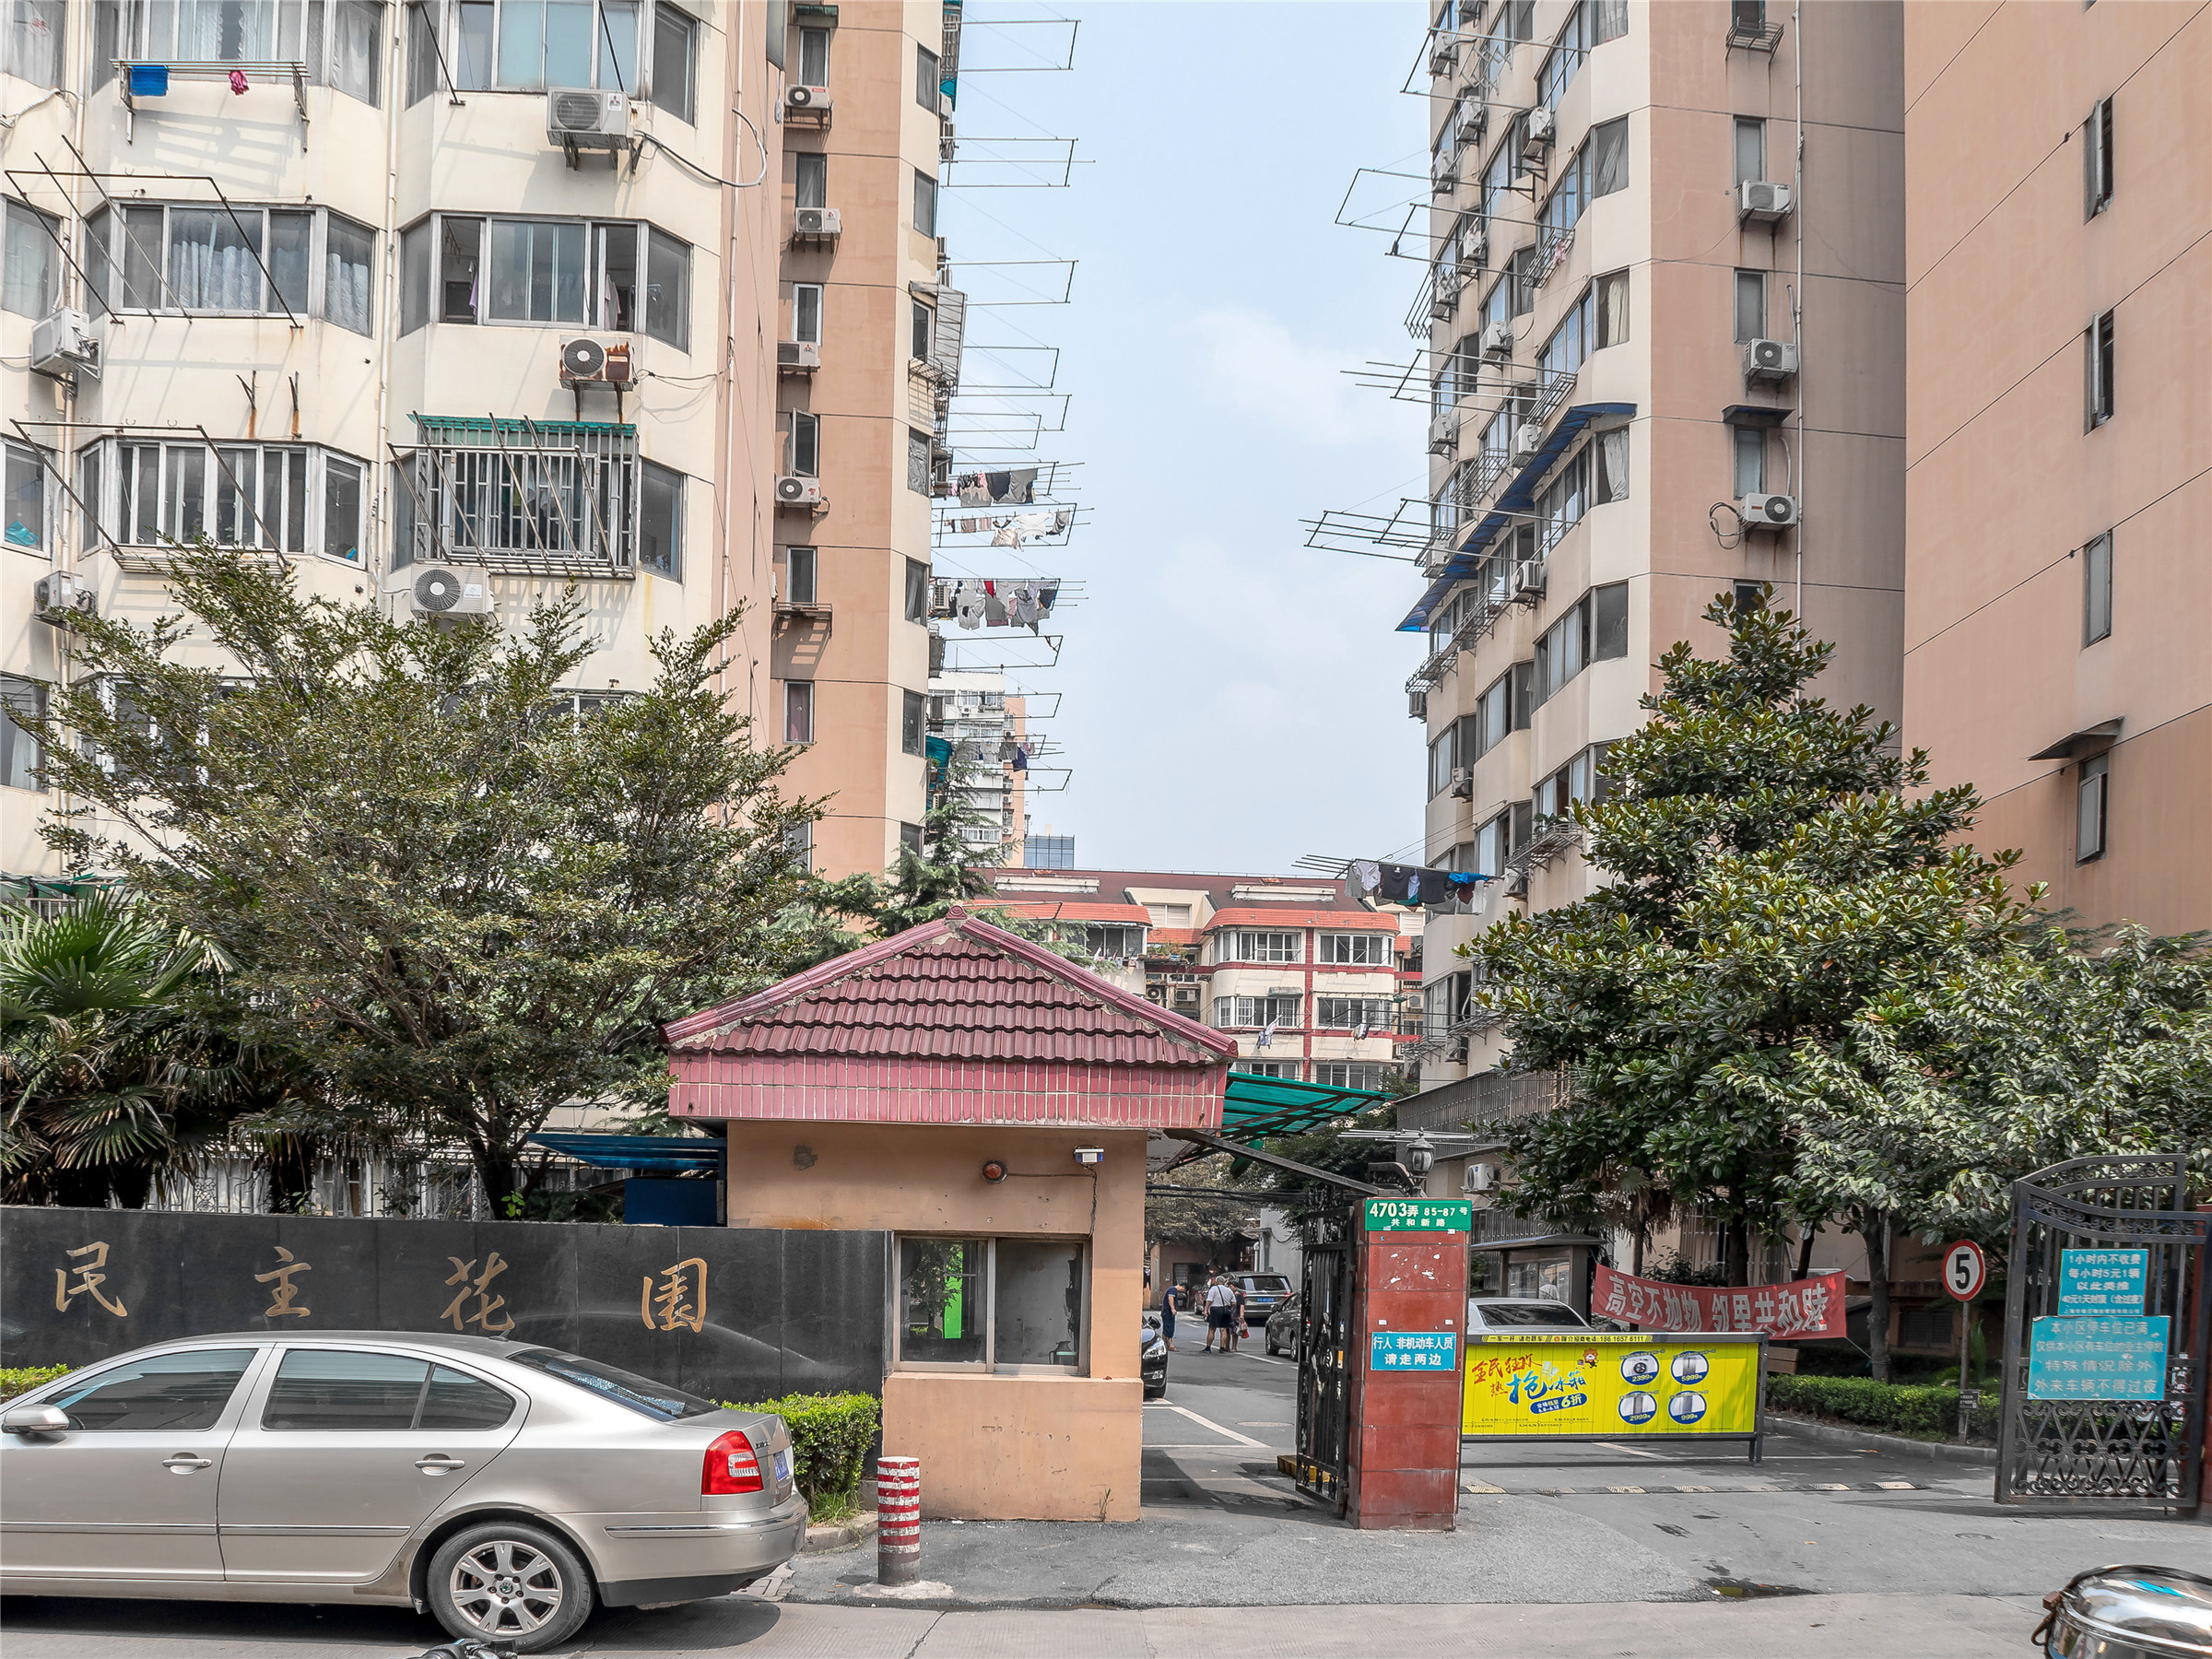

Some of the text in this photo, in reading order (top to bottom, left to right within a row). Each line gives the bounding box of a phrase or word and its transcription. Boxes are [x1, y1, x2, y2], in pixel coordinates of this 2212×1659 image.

[1370, 1203, 1419, 1218] 4703弄
[1391, 1218, 1446, 1227] 共和新路
[2069, 1253, 2142, 1265] 1小时内不收费
[1955, 1253, 1971, 1290] 5
[2068, 1268, 2141, 1279] 每小时5元1辆
[2077, 1282, 2130, 1291] 以此类推
[1605, 1274, 1829, 1336] 高空不抛物 邻里共和睦
[2050, 1321, 2149, 1335] 本小区停车位已满
[1373, 1336, 1453, 1350] 行人 非机动车人员
[1384, 1353, 1442, 1366] 请走两边
[2044, 1359, 2152, 1372] 特殊情况除外
[2034, 1379, 2158, 1394] 外来车辆不得过夜
[1561, 1394, 1583, 1407] 6折
